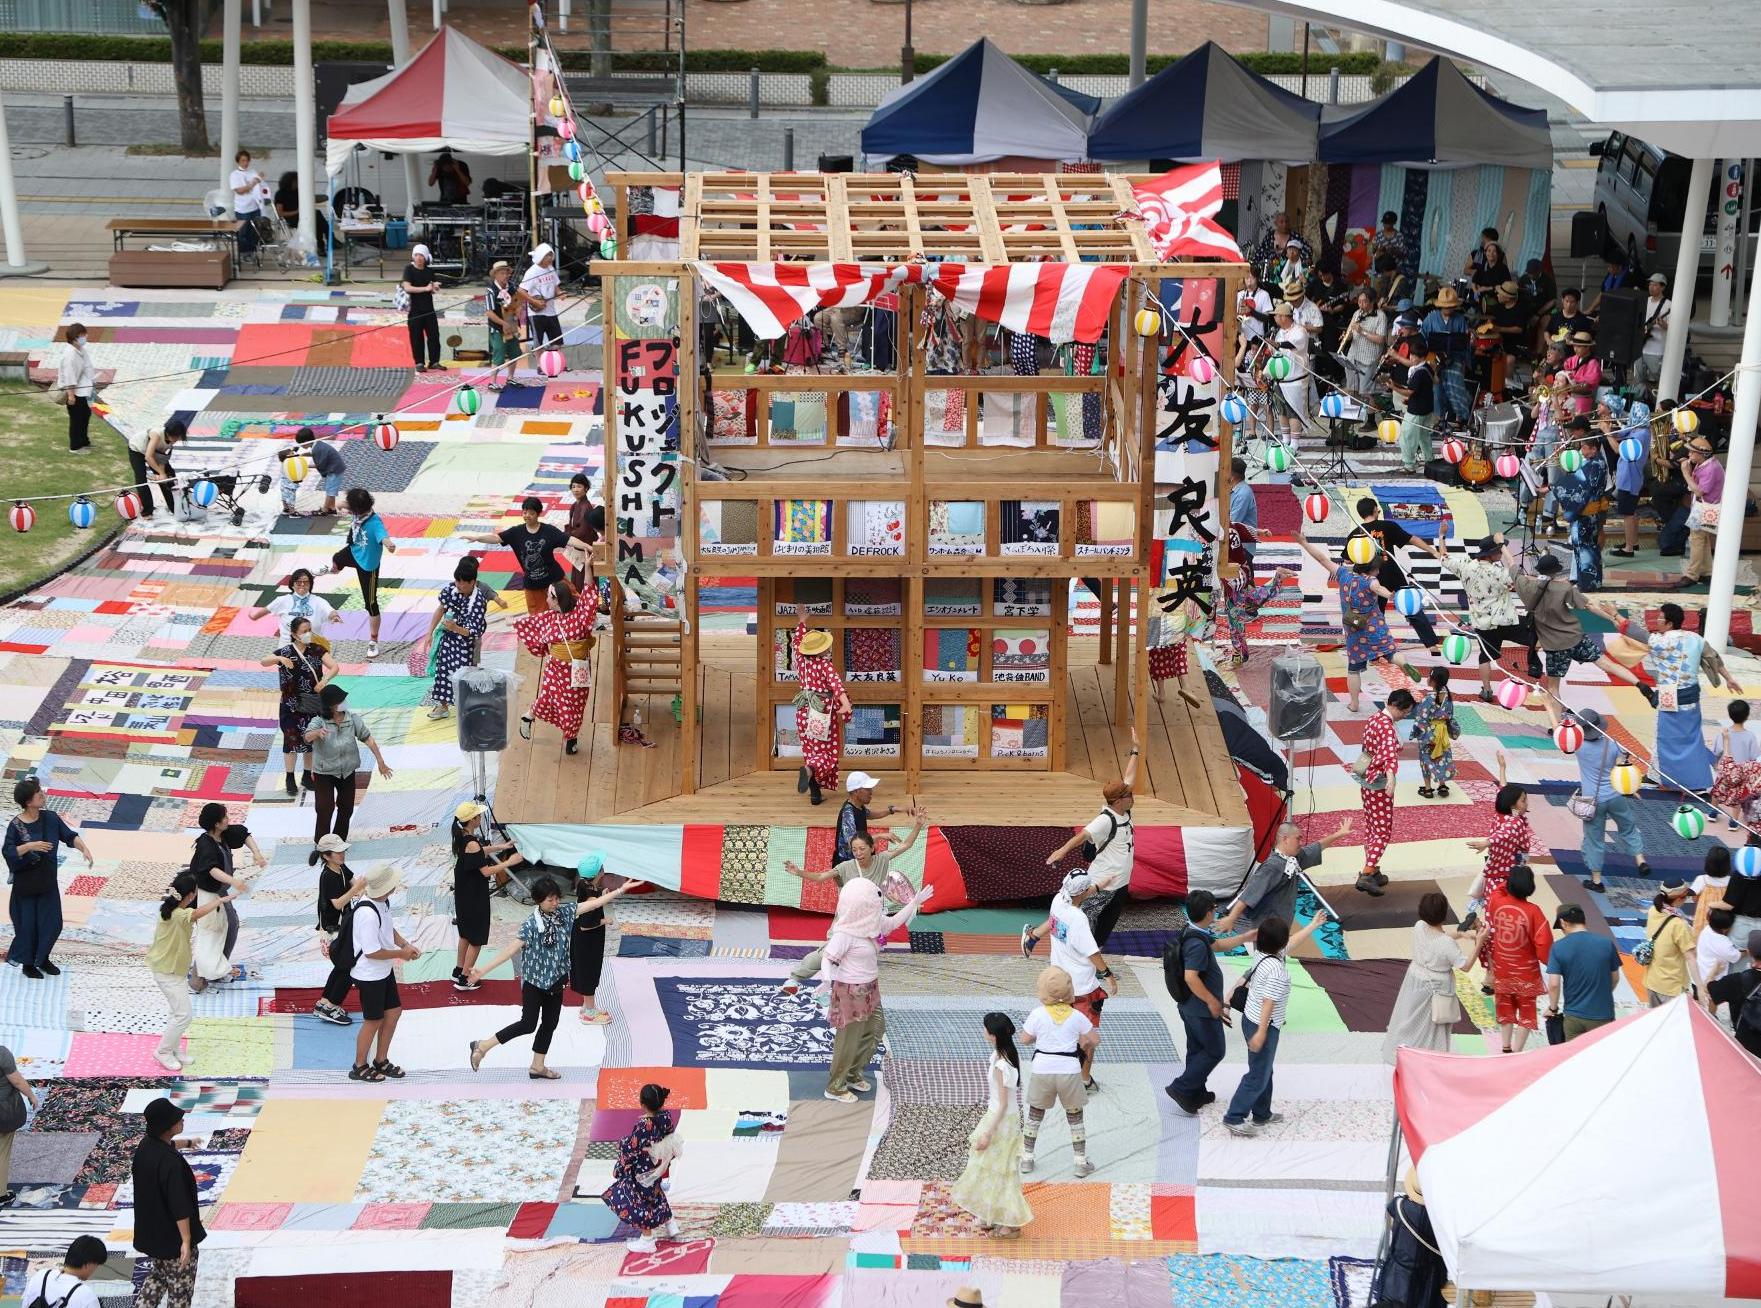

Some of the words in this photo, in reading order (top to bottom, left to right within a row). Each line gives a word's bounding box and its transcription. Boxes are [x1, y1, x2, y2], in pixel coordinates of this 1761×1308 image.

[646, 335, 681, 528] プロジェクト
[1156, 306, 1220, 614] 大友良英
[851, 546, 899, 556] DEFROCK
[1003, 605, 1040, 617] 宮下学
[850, 672, 897, 682] 大友良英
